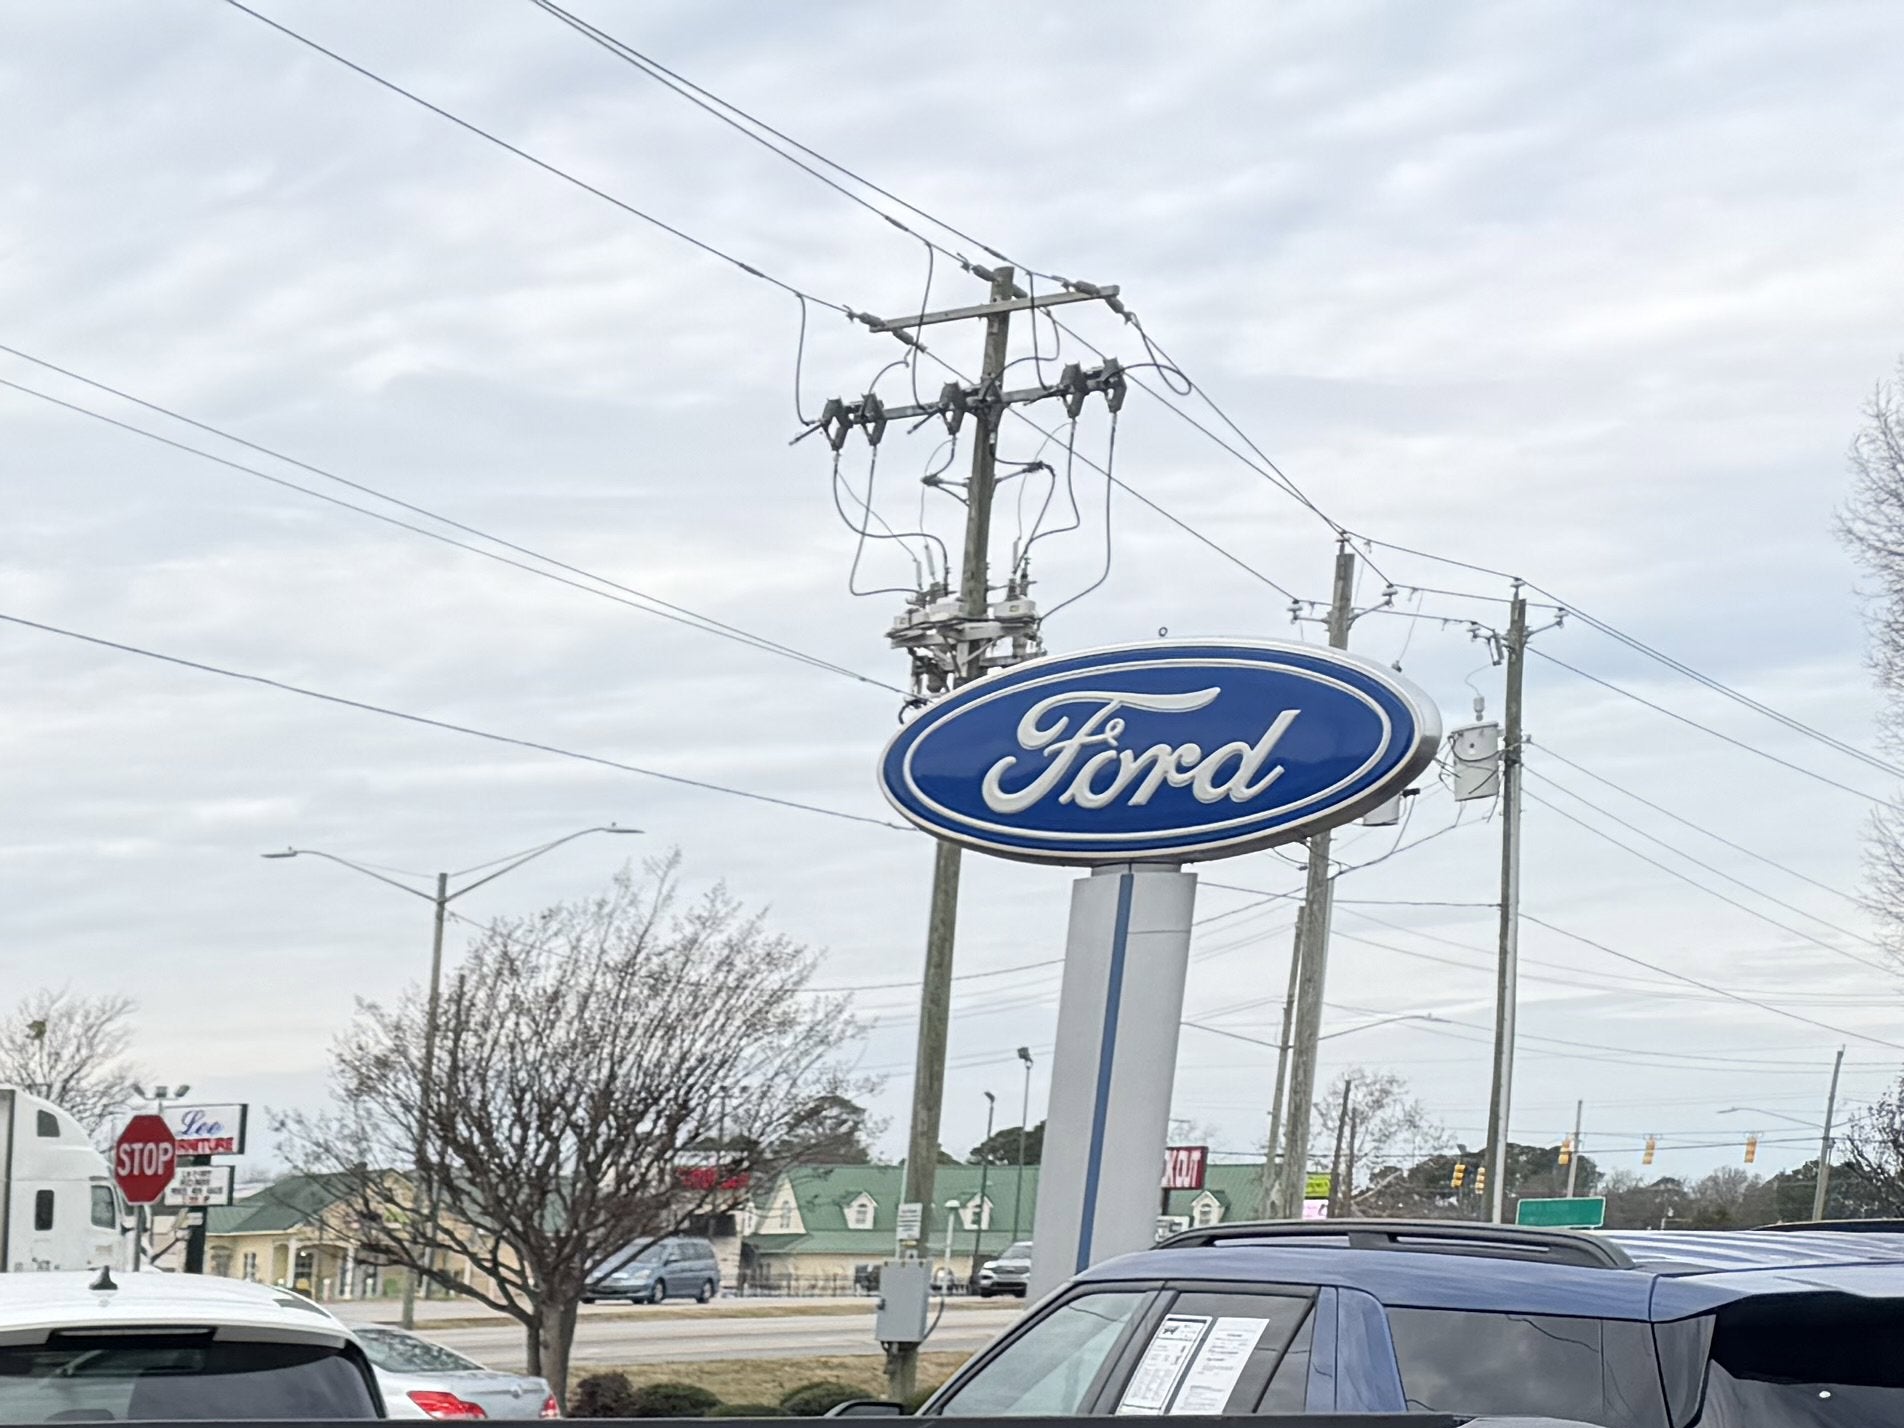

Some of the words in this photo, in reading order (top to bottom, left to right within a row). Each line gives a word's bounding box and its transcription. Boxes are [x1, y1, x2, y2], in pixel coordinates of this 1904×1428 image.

[982, 686, 1300, 814] Ford
[176, 1109, 223, 1136] Lee
[116, 1142, 173, 1177] STOP
